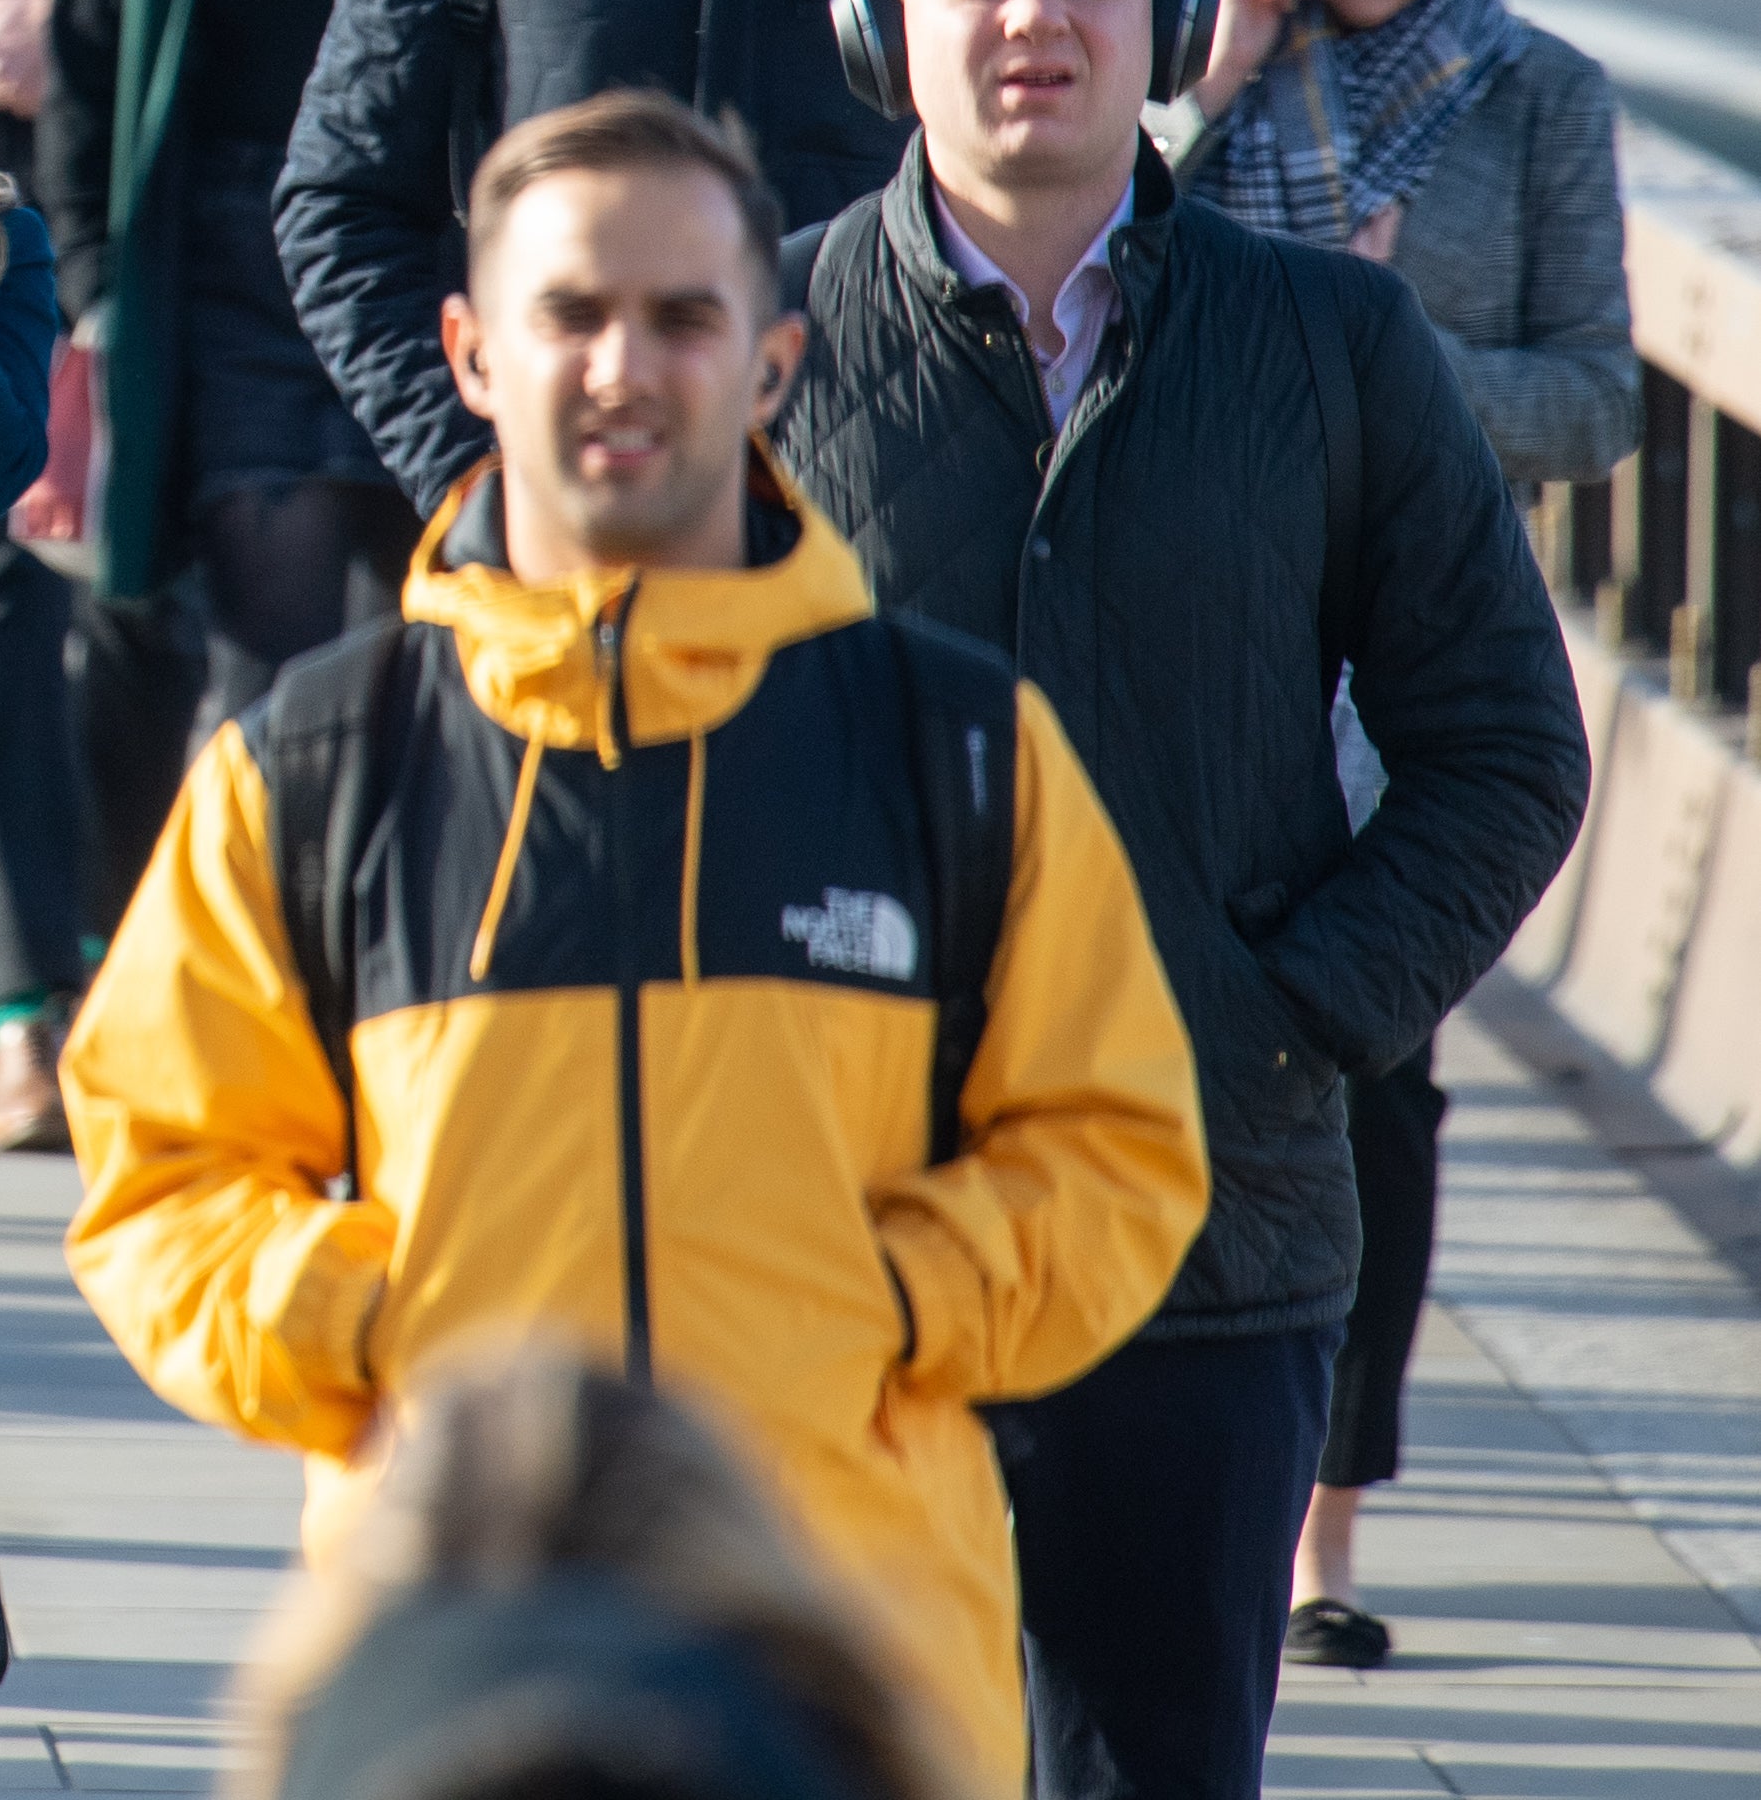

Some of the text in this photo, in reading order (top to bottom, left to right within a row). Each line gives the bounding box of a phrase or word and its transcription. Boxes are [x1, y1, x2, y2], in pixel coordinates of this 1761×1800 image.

[822, 886, 873, 914] THE
[781, 904, 873, 952] NORTH
[808, 939, 871, 974] FACE
